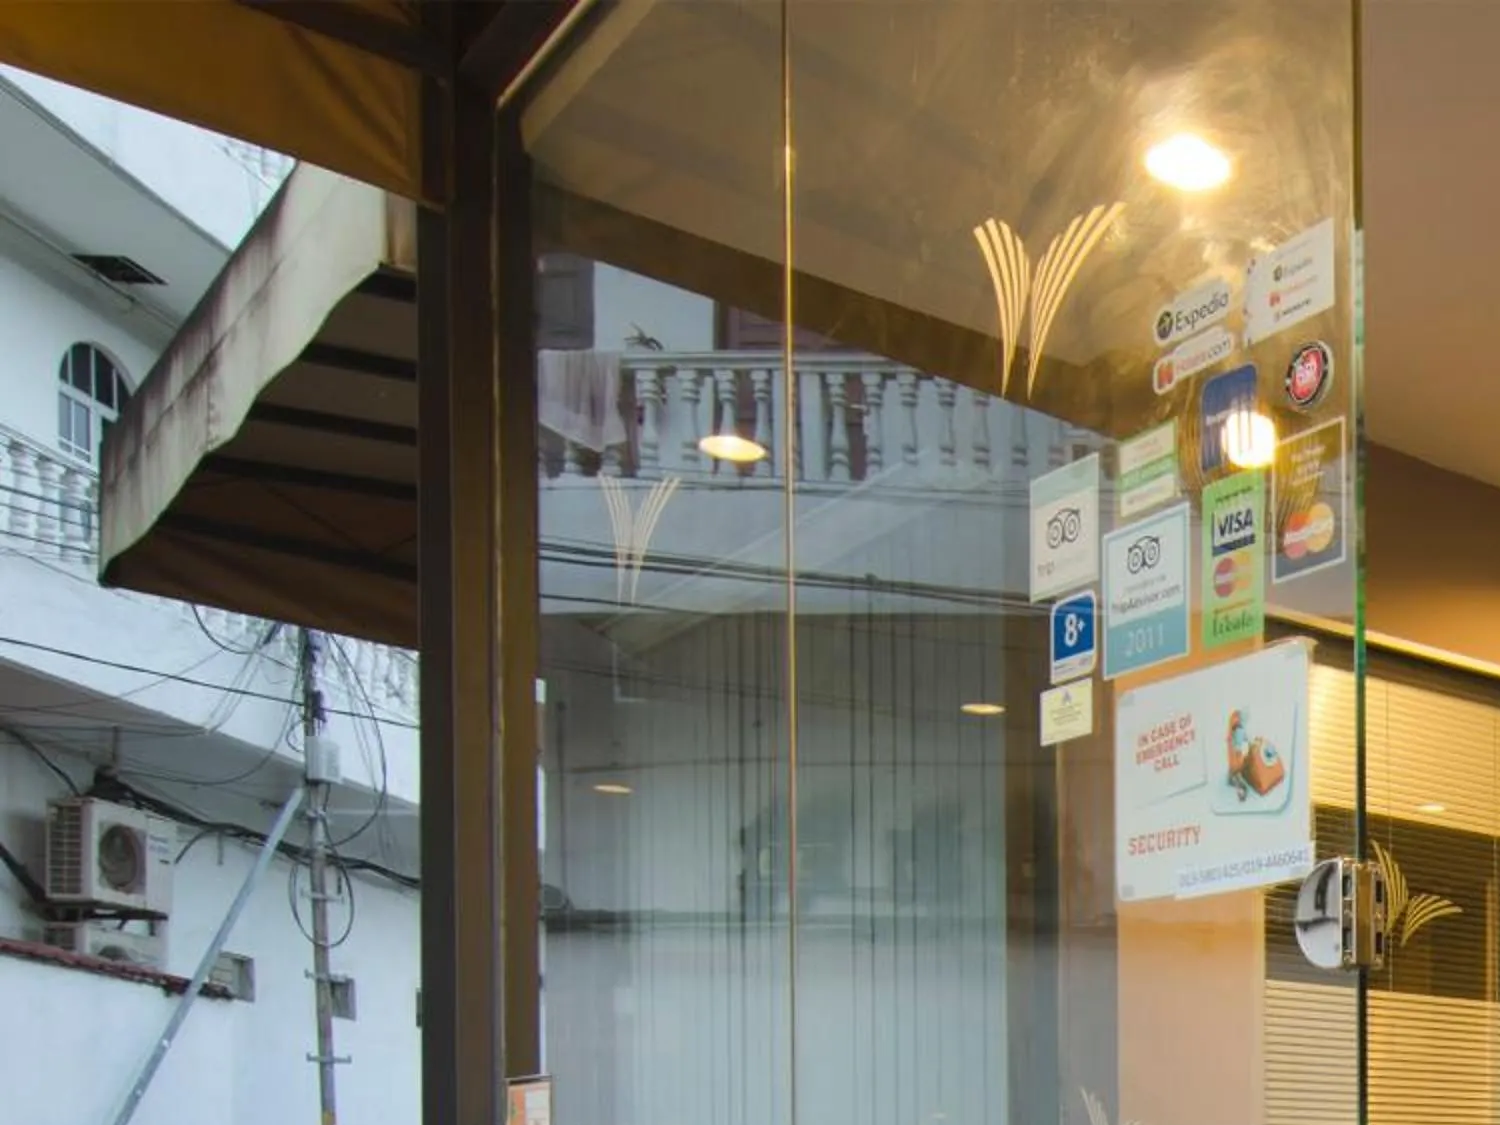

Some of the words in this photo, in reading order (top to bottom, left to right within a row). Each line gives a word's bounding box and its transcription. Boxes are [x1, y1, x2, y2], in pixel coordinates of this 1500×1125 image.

[1217, 507, 1254, 537] VISA
[1150, 719, 1177, 743] CASE
[1154, 752, 1181, 773] CALL
[1127, 823, 1201, 857] SECURITY
